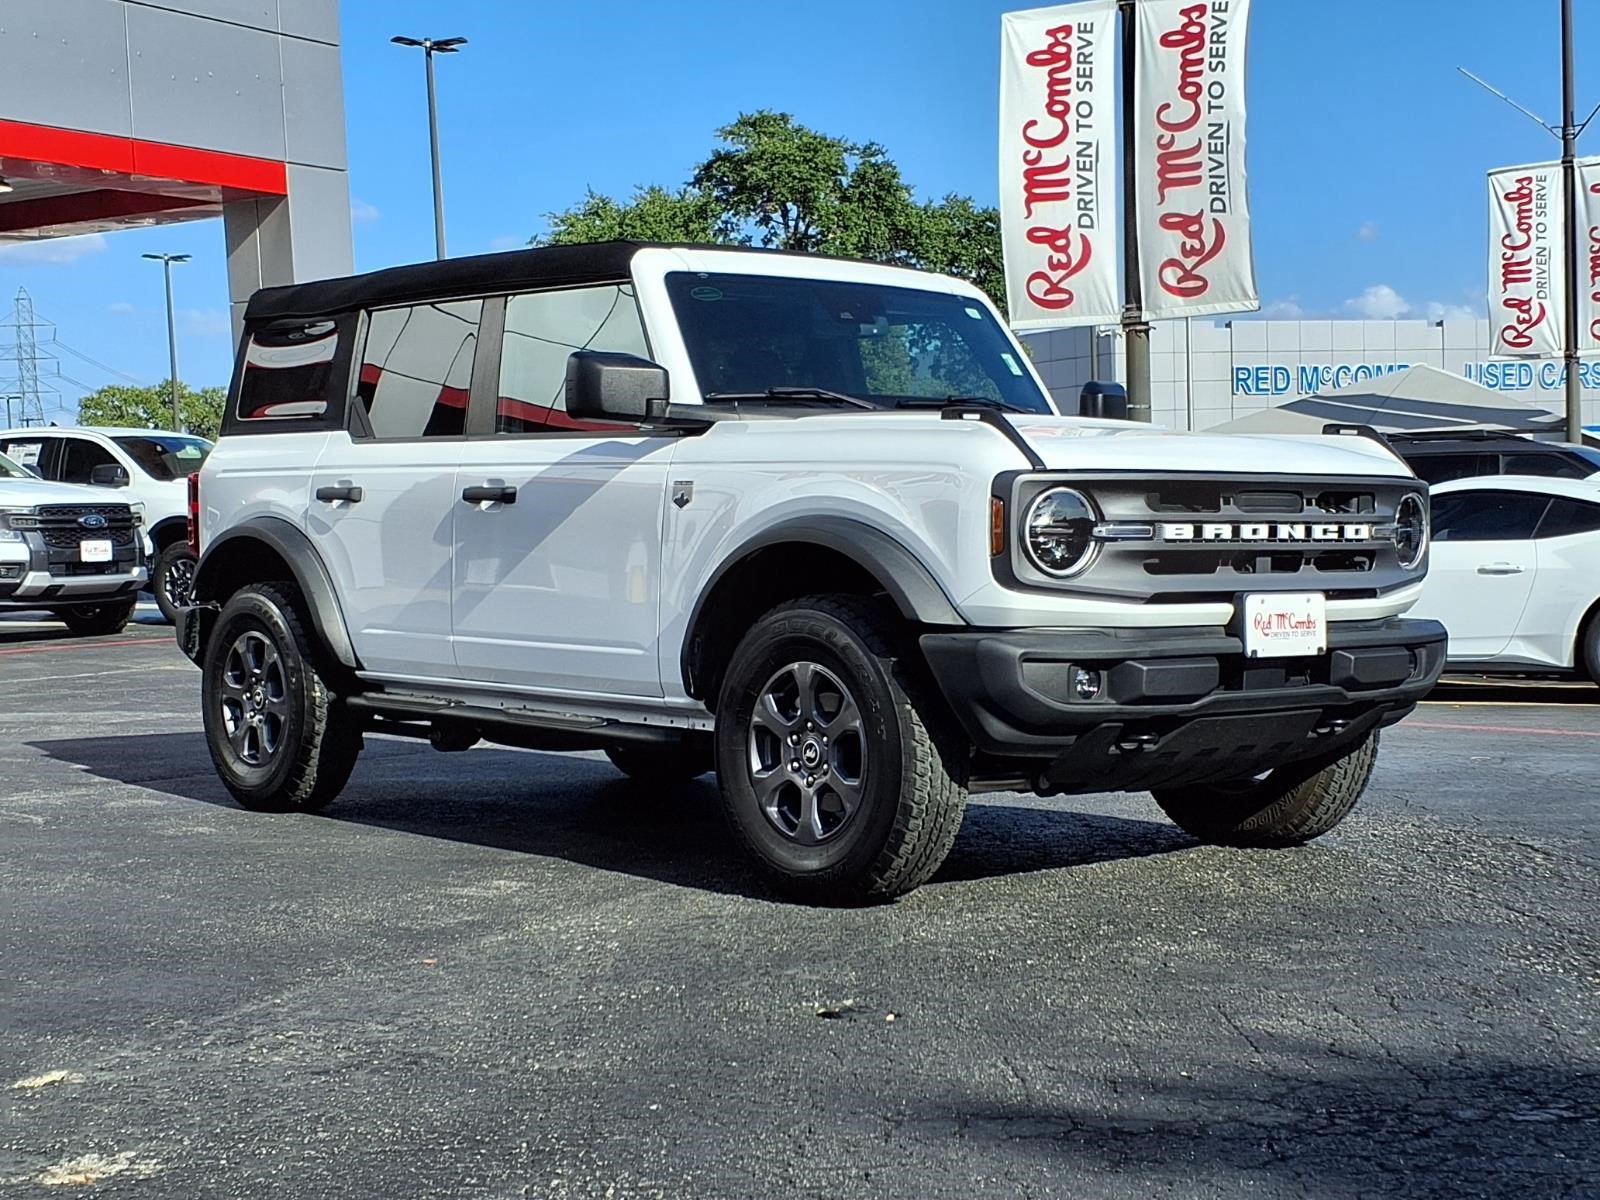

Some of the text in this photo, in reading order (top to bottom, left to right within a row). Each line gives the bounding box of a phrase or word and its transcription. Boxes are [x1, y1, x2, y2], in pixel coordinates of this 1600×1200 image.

[1022, 24, 1092, 310] Red McCombs
[1075, 21, 1095, 230] DRIVEN TO SERVE
[1156, 3, 1226, 298] Red McCombs
[1207, 1, 1229, 214] DRIVEN TO SERVE
[1501, 176, 1546, 348] Red McCombs
[1536, 174, 1548, 300] DRIVEN TO SERVE
[1233, 365, 1291, 394] RED
[1464, 362, 1534, 389] USED
[1162, 523, 1370, 541] BRONCO
[1254, 612, 1317, 636] Red McCombs
